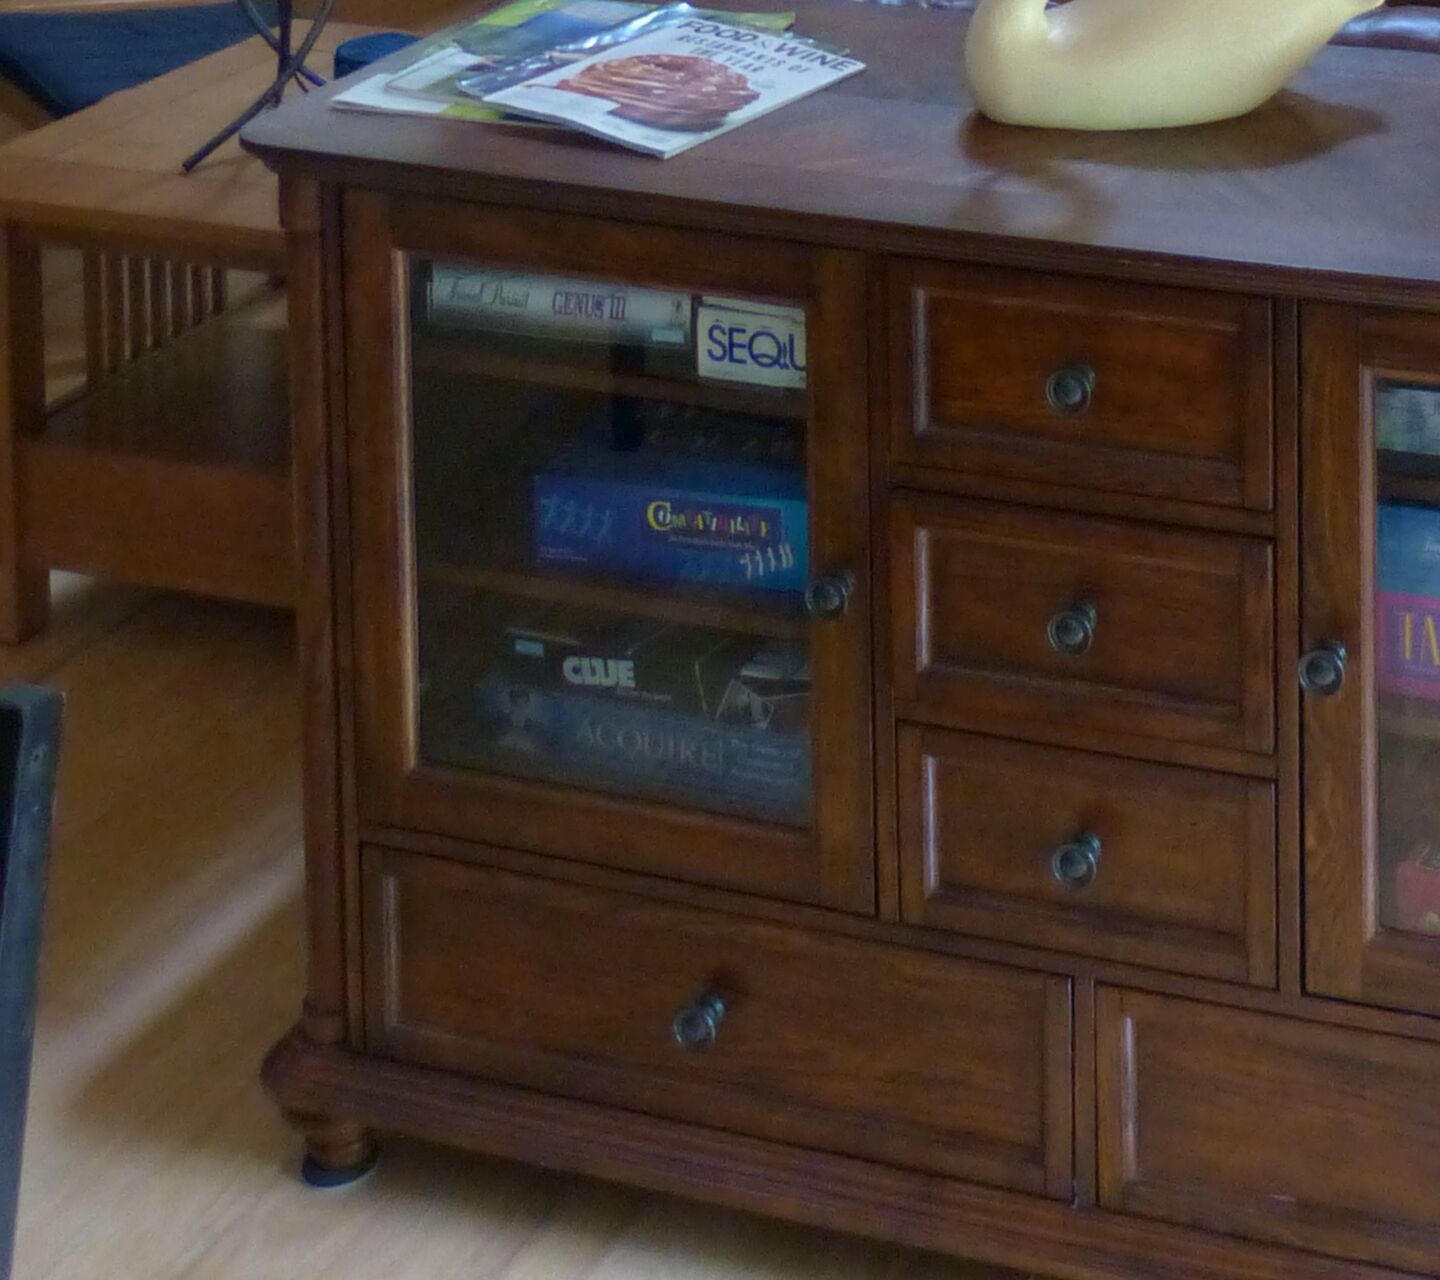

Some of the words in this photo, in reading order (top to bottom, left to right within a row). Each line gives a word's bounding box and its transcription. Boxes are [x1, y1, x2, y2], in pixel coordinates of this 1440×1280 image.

[675, 34, 786, 67] RESTAURANTS
[677, 19, 758, 42] FOOD
[773, 41, 860, 72] WINE
[551, 290, 604, 320] GENUS
[562, 655, 637, 689] CLUE
